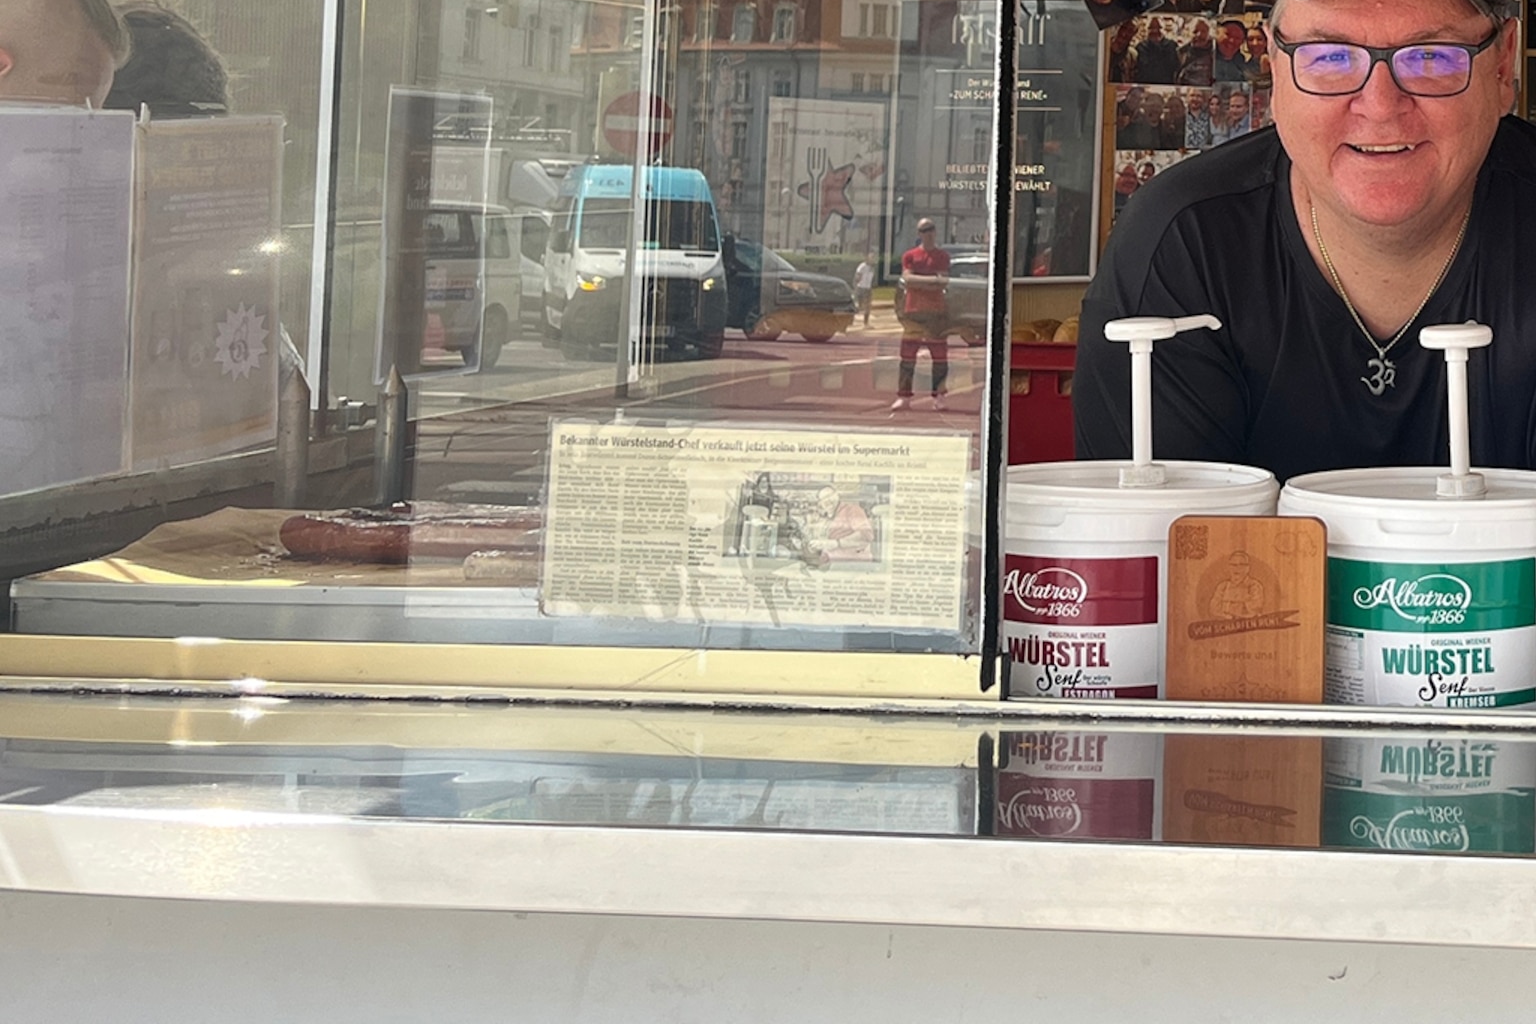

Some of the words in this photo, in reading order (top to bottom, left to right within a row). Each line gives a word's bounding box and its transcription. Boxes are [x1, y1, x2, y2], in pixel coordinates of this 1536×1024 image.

[559, 434, 608, 447] Bekannter
[611, 435, 700, 450] Würstelstand-Chef
[703, 438, 744, 452] verkauft
[745, 441, 768, 453] jetzt
[770, 442, 795, 453] seine
[799, 443, 836, 454] Würstel
[838, 444, 849, 454] im
[853, 444, 910, 456] Supermarkt
[1003, 567, 1083, 608] Albatros
[1354, 576, 1468, 611] Albatros
[1047, 602, 1081, 617] 1866
[1429, 610, 1465, 624] 1866
[1048, 631, 1078, 639] ORIGINAL
[1080, 631, 1107, 639] WIENER
[1194, 625, 1212, 636] VOM
[1214, 620, 1255, 634] SCHARFEN
[1466, 637, 1491, 645] WIENER
[1008, 634, 1110, 667] WÜRSTEL
[1211, 651, 1250, 661] Bewerte
[1254, 651, 1278, 661] uns!
[1382, 644, 1495, 675] WÜRSTEL
[1036, 664, 1083, 692] Senf
[1063, 689, 1116, 698] ESTRAGON
[1418, 672, 1469, 702] Senf
[1450, 695, 1497, 708] KREMSER
